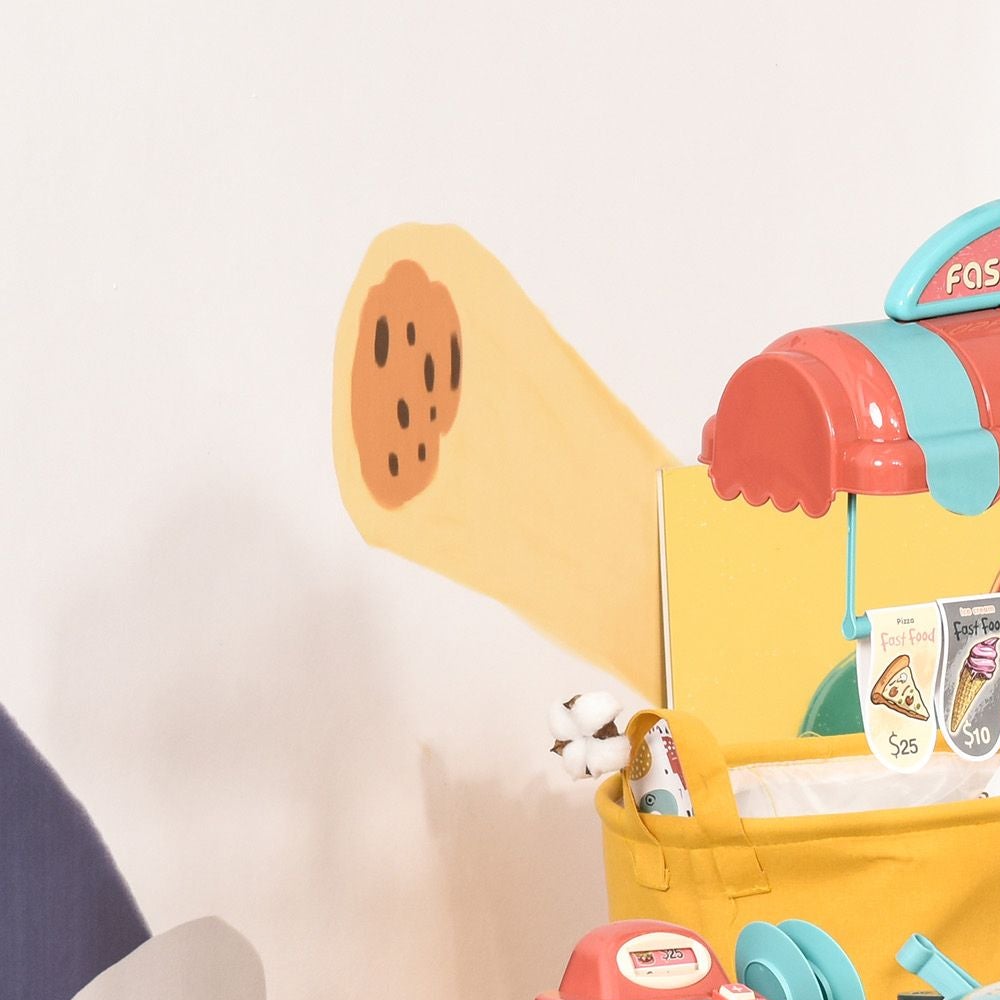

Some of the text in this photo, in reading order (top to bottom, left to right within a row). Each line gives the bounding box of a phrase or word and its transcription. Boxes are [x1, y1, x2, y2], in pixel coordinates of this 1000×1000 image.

[896, 617, 915, 625] Pizza
[953, 620, 979, 641] Fast
[880, 628, 936, 652] Fast Food
[889, 731, 919, 758] $25
[963, 721, 991, 748] $10
